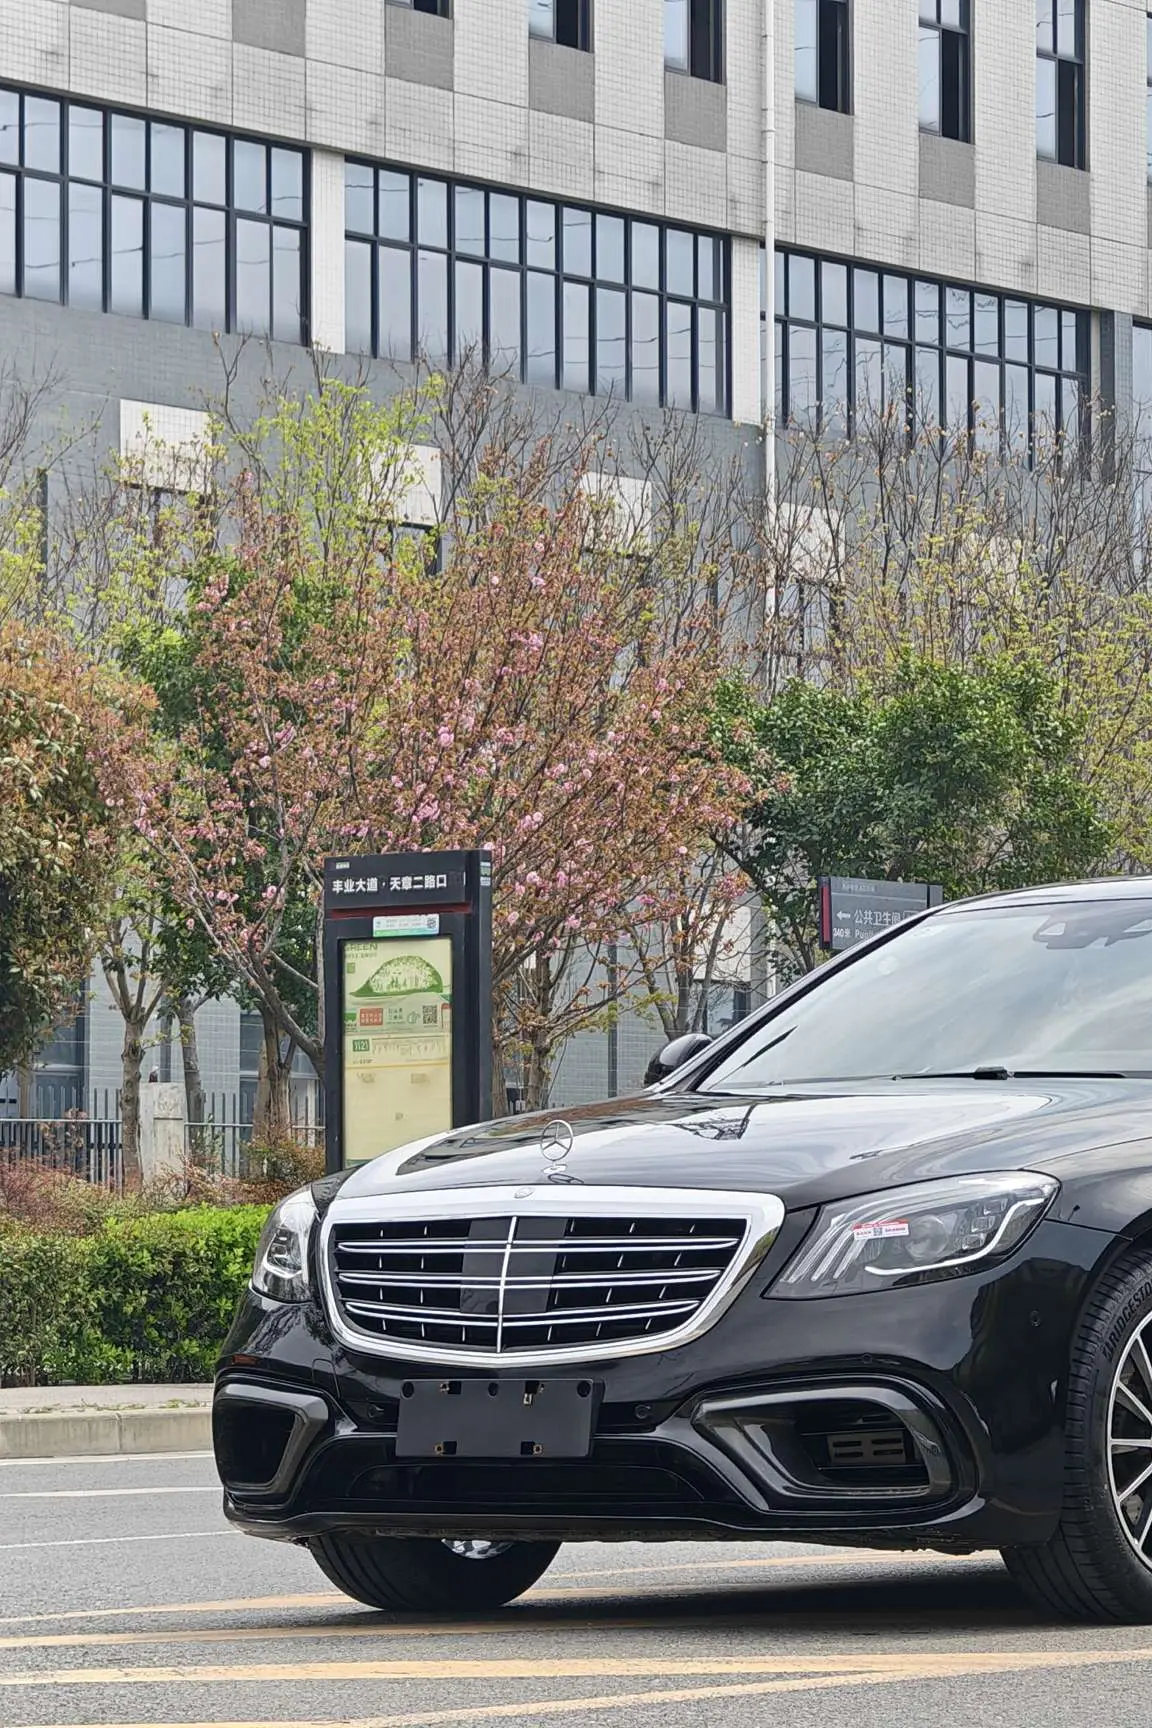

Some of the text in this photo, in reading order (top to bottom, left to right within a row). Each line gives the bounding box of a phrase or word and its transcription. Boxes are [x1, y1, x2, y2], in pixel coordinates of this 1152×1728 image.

[854, 908, 901, 926] 公共卫生间
